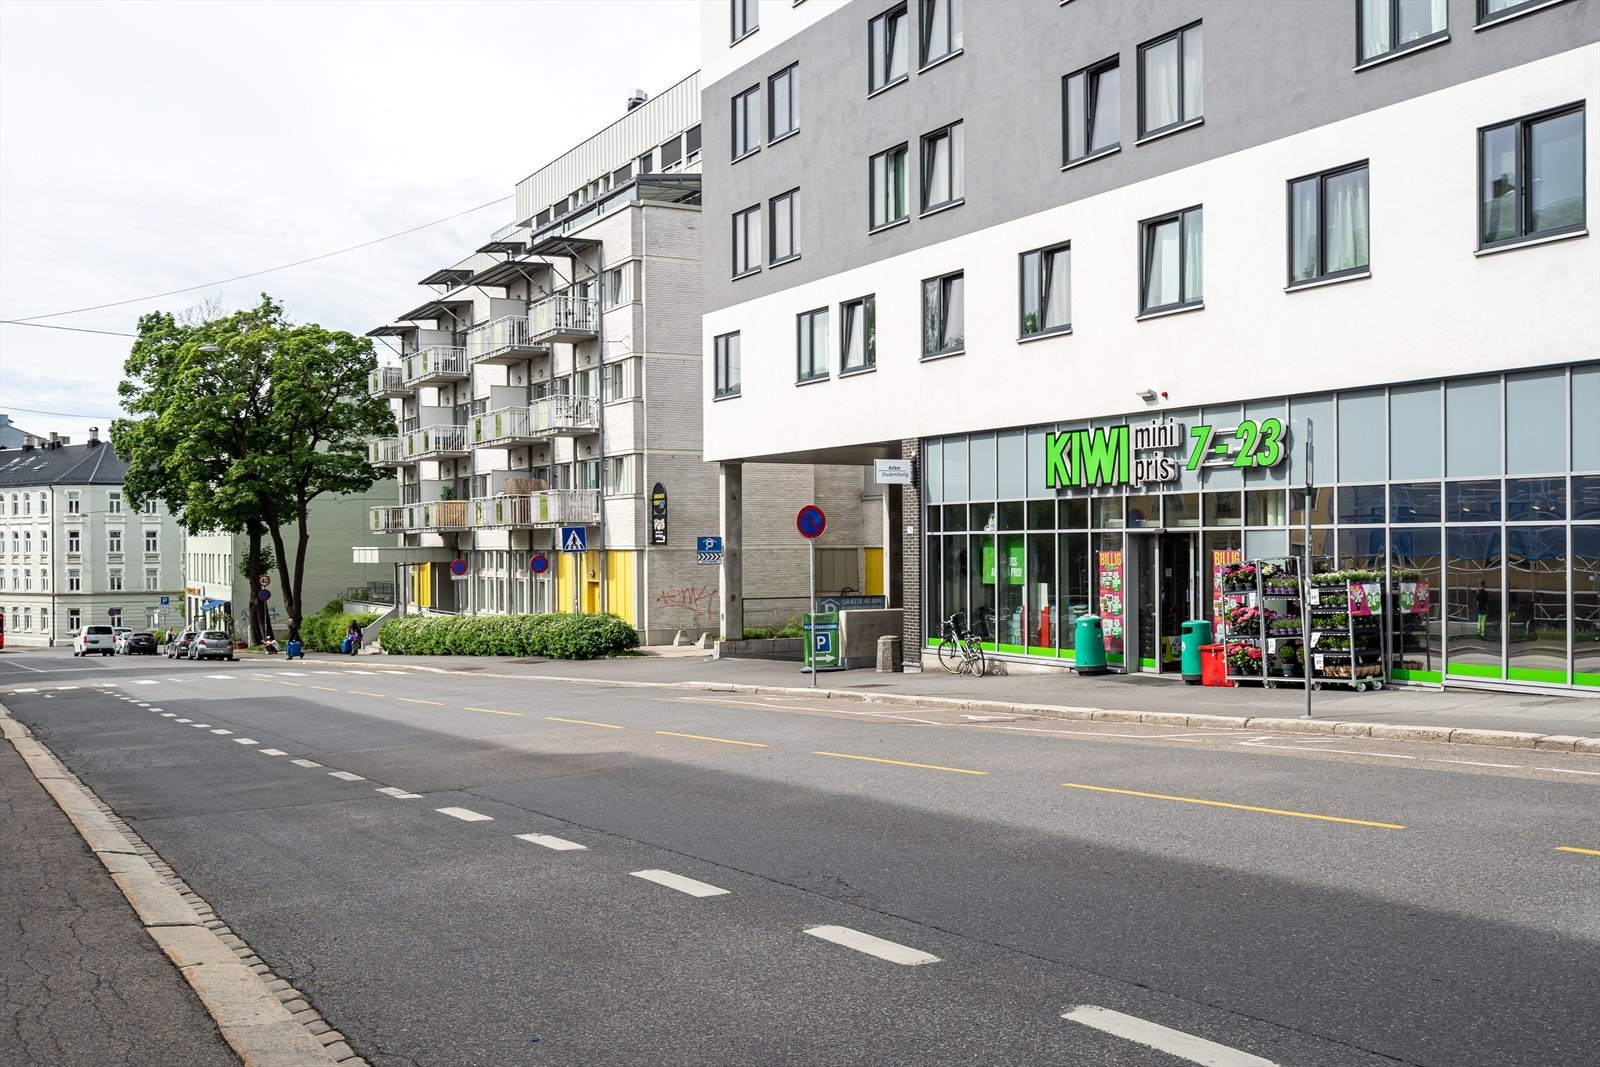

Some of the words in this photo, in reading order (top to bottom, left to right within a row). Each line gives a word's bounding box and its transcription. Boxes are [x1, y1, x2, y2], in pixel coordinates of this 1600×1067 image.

[1135, 417, 1175, 449] mini
[1046, 424, 1130, 489] KIWI
[1135, 451, 1172, 488] pris
[1100, 552, 1122, 566] BILLIG
[1214, 551, 1240, 566] BILLIG
[260, 577, 269, 585] 40
[816, 635, 827, 650] P
